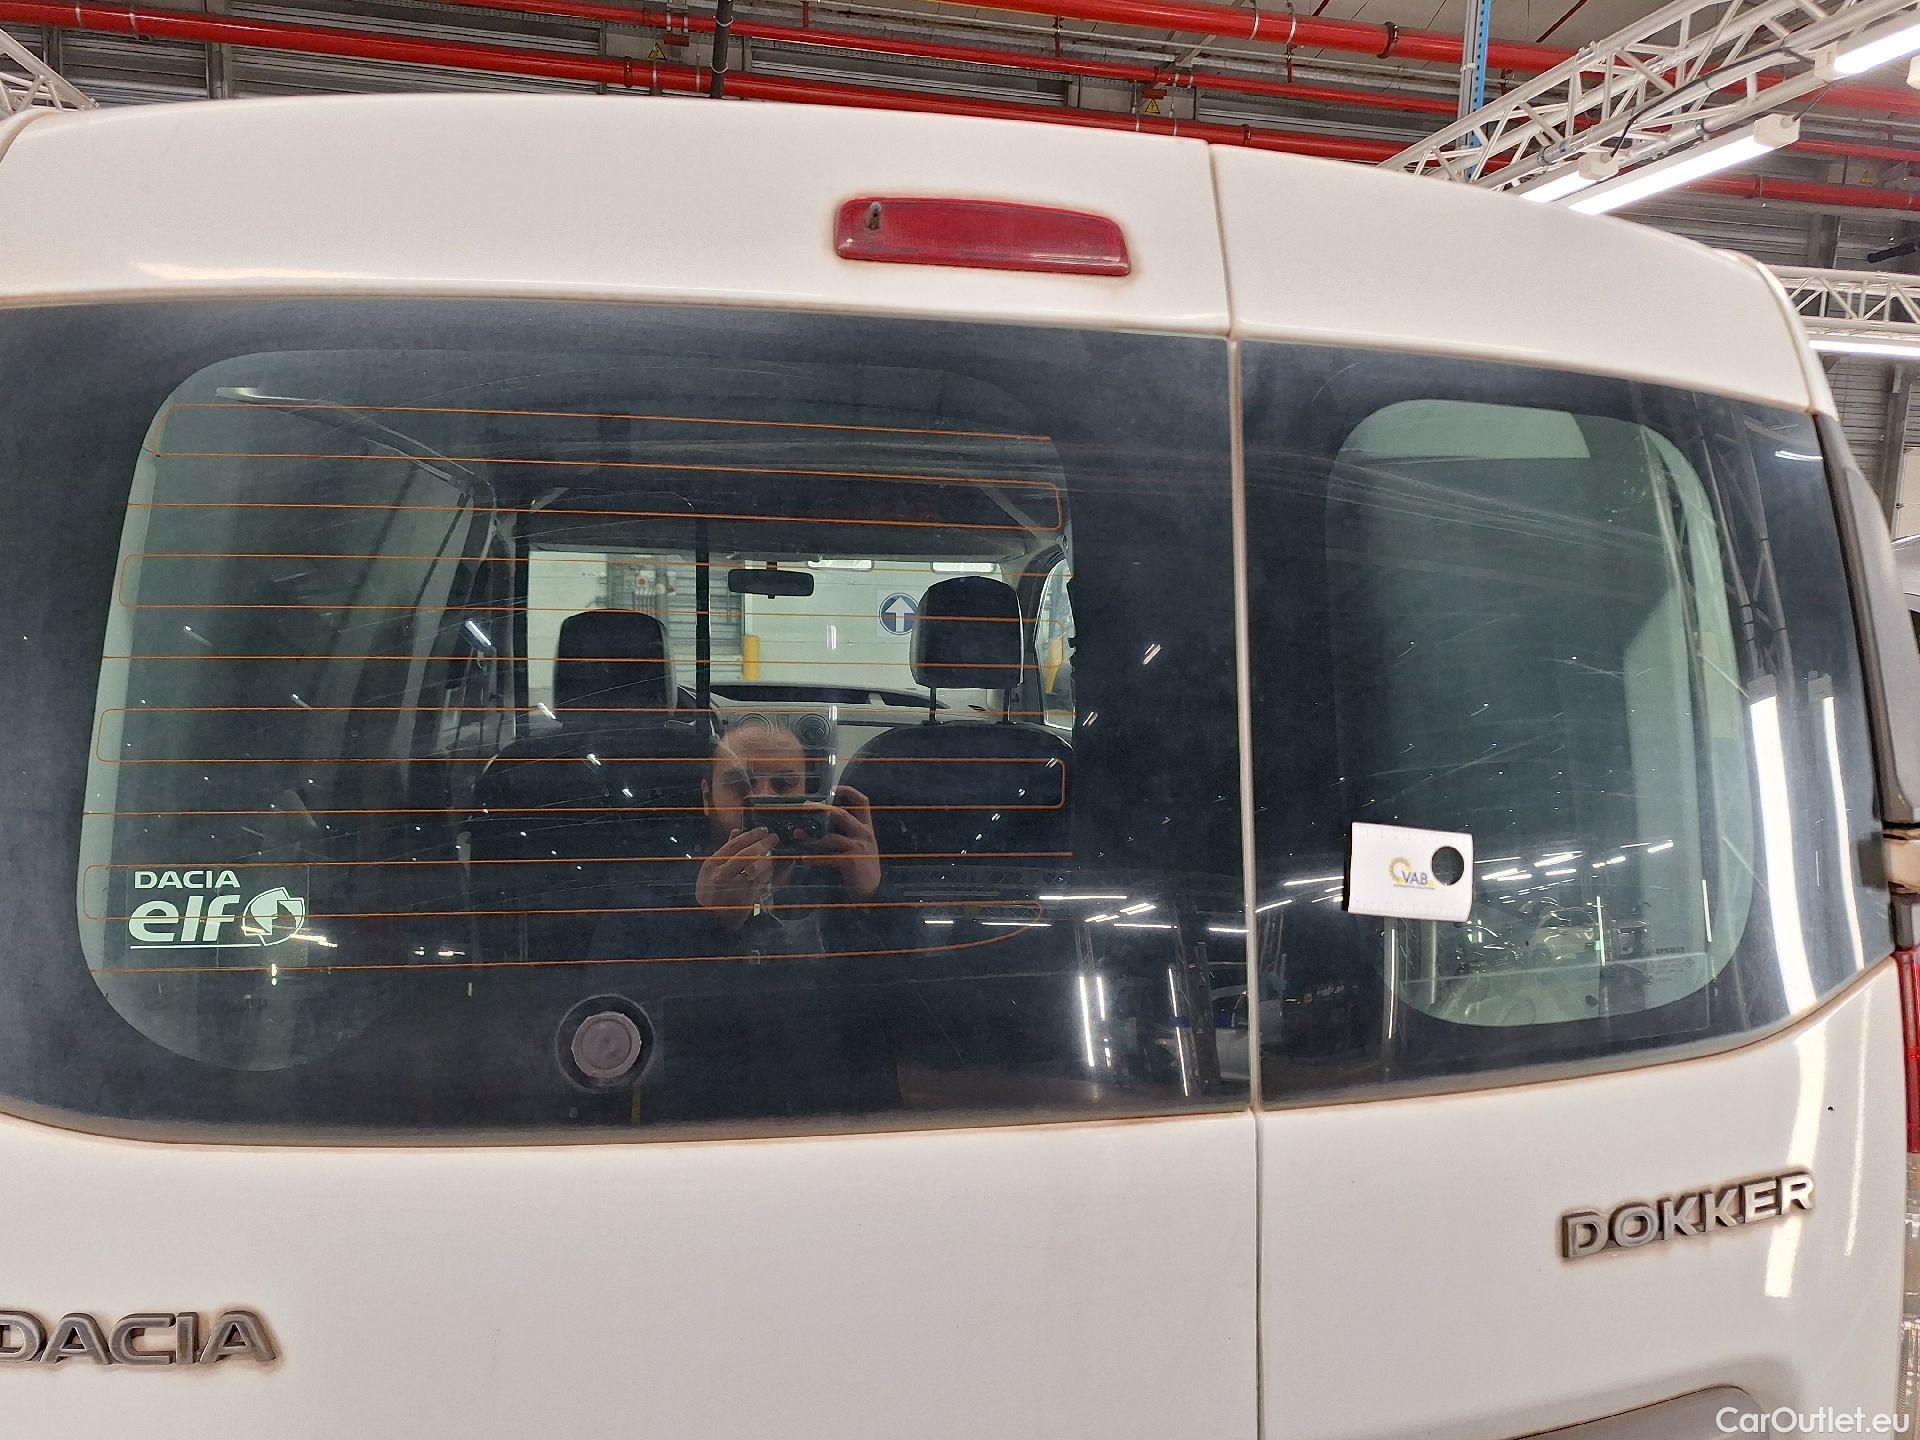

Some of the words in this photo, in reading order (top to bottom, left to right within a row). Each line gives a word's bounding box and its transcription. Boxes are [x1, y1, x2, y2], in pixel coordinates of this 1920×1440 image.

[134, 870, 240, 889] DACIA
[1401, 870, 1428, 885] VAB
[129, 894, 241, 942] elf
[1562, 1171, 1815, 1258] DOKKER
[0, 1310, 276, 1365] DACIA
